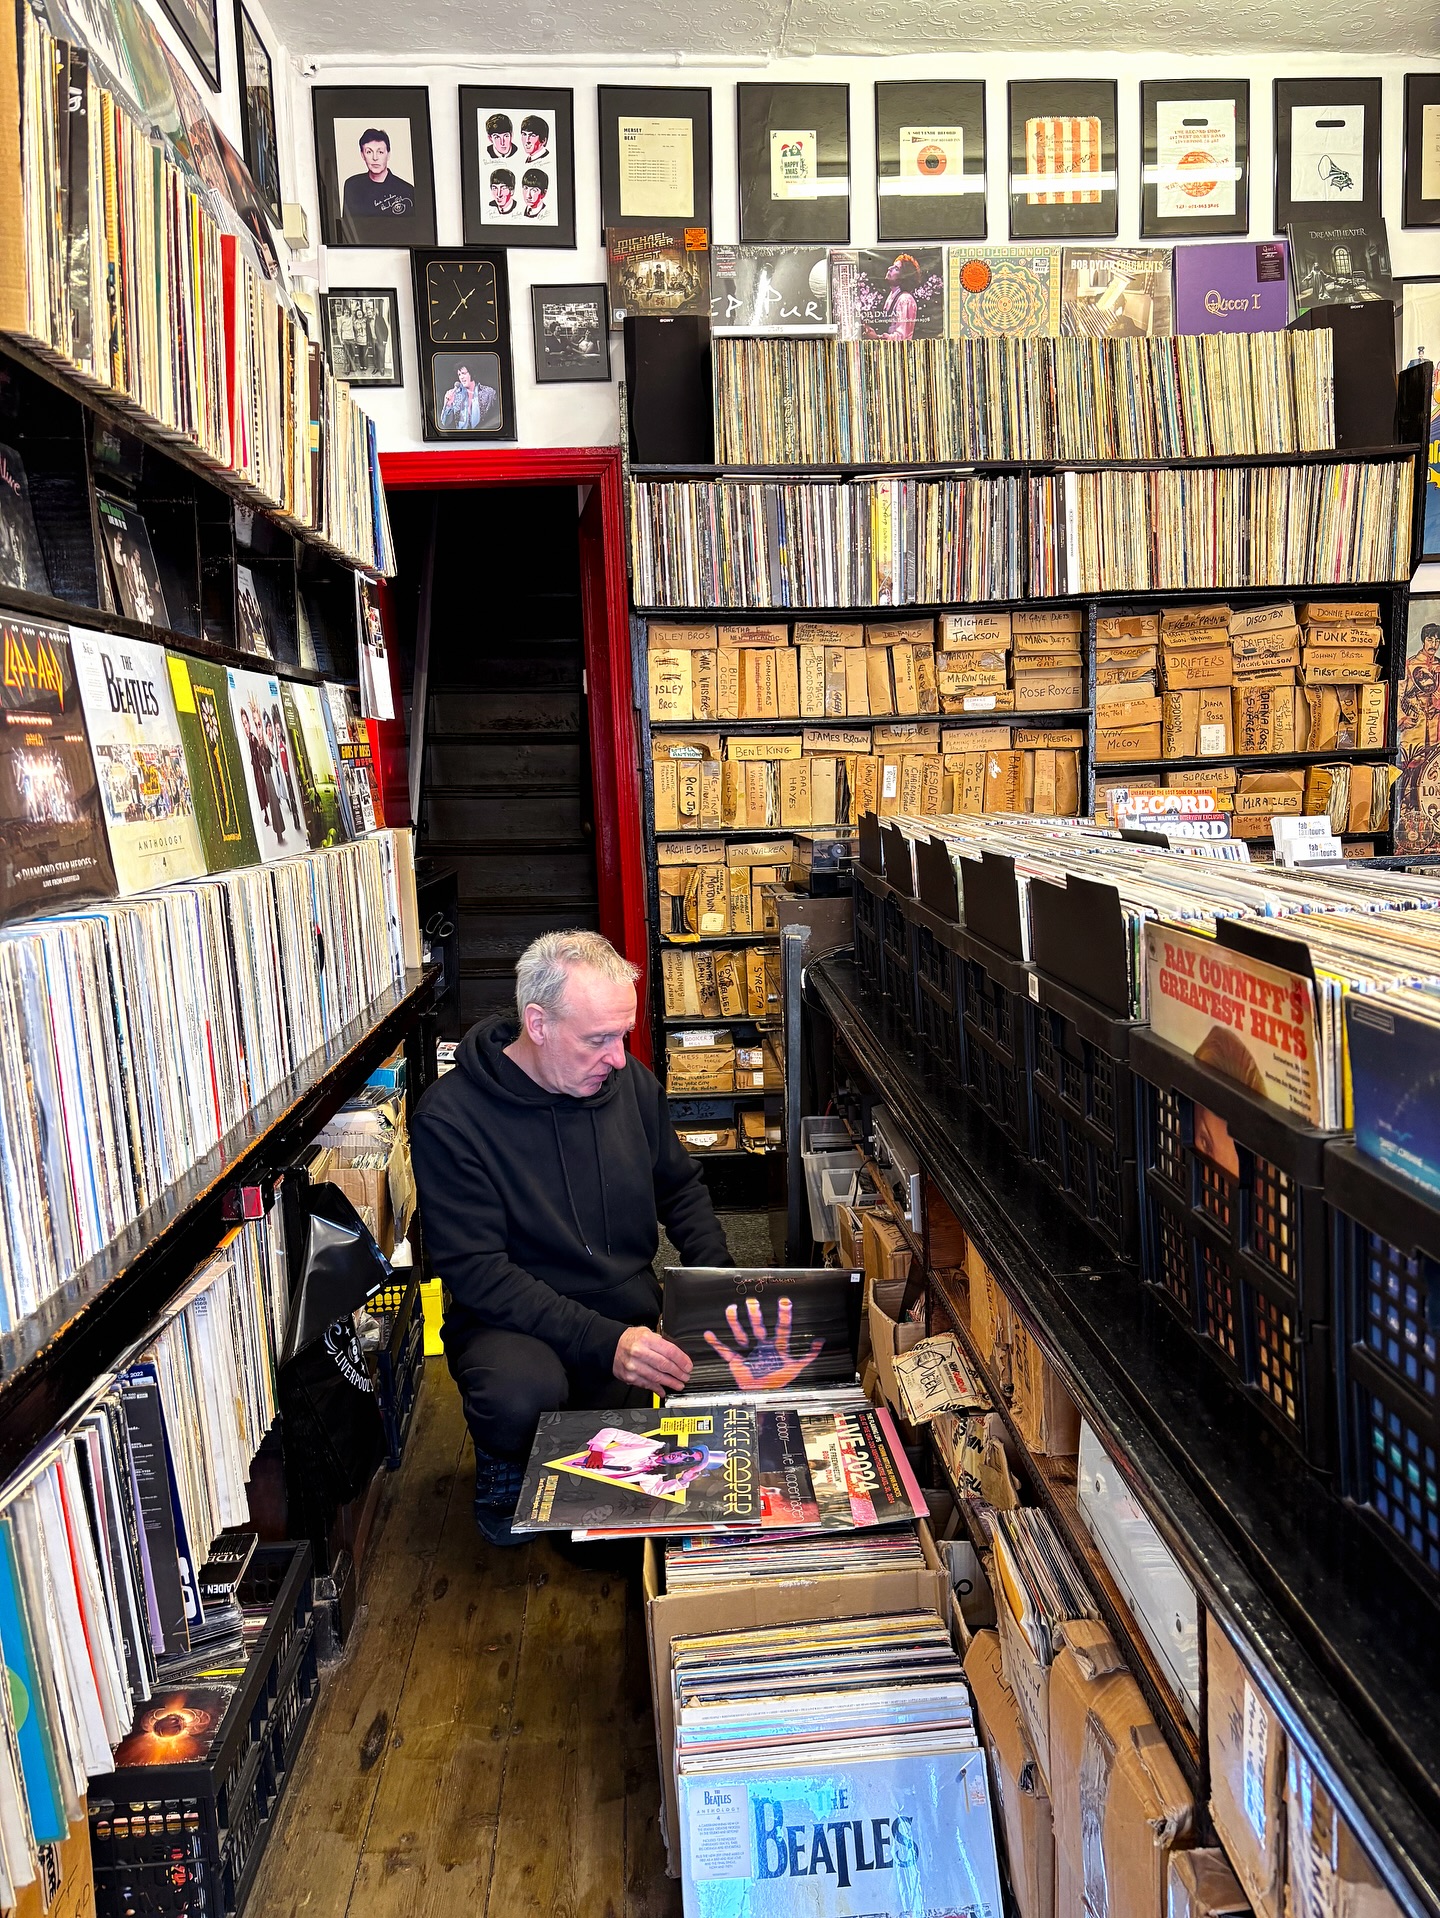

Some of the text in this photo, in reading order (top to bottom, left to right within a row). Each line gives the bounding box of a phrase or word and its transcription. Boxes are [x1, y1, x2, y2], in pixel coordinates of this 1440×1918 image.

[613, 238, 674, 256] SCHENKER
[617, 232, 670, 248] MICHAEL
[1071, 260, 1088, 270] BOB
[1117, 260, 1163, 271] FRAGMENTS
[855, 309, 901, 318] BOB DYLAN
[954, 617, 998, 626] MICHAEL
[1246, 615, 1267, 626] DISCO
[655, 631, 711, 641] ISLEY BROS
[952, 631, 1000, 642] JACKSON
[1316, 631, 1348, 643] FUNK
[120, 654, 133, 671] THE
[1170, 656, 1225, 668] DRIFTERS
[4, 628, 64, 713] LEPPARD
[947, 673, 978, 683] MARVIN
[1186, 668, 1214, 679] BELL
[1313, 668, 1371, 678] FIRST CHOICE
[101, 652, 160, 725] BEATLES
[655, 684, 683, 695] ISLEY
[720, 667, 728, 697] OCEAN
[805, 658, 814, 713] BLOODSTONE
[815, 681, 823, 708] MAGIC
[1020, 686, 1045, 699] ROSE
[1048, 684, 1080, 696] ROYCE
[658, 699, 678, 709] BROS
[1201, 700, 1224, 710] DIANA
[808, 731, 868, 743] JAMES BROWN
[1018, 732, 1073, 744] BILLY PRESTON
[1102, 730, 1124, 738] VAN
[735, 746, 755, 758] BEN
[766, 745, 791, 756] KING
[685, 776, 698, 798] RICK
[799, 765, 808, 796] ISAAC
[789, 776, 797, 809] HAYES
[710, 795, 720, 816] TINA
[1117, 795, 1216, 815] RECORD
[1243, 797, 1298, 810] MIRACLES
[138, 836, 183, 851] ANTHOLOGY
[1309, 843, 1319, 851] fab
[162, 857, 167, 868] 4
[706, 875, 716, 912] MOTOWN
[753, 966, 765, 1009] SYRETA
[1164, 943, 1305, 1025] RAY CONNIFF'S
[1159, 968, 1307, 1061] GREATEST HITS
[837, 1414, 880, 1494] LIVE 2024
[723, 1408, 752, 1516] ALICE COOPER
[825, 1469, 833, 1483] DYLAN
[704, 1790, 732, 1807] BEATLES
[753, 1798, 919, 1888] BEATLES
